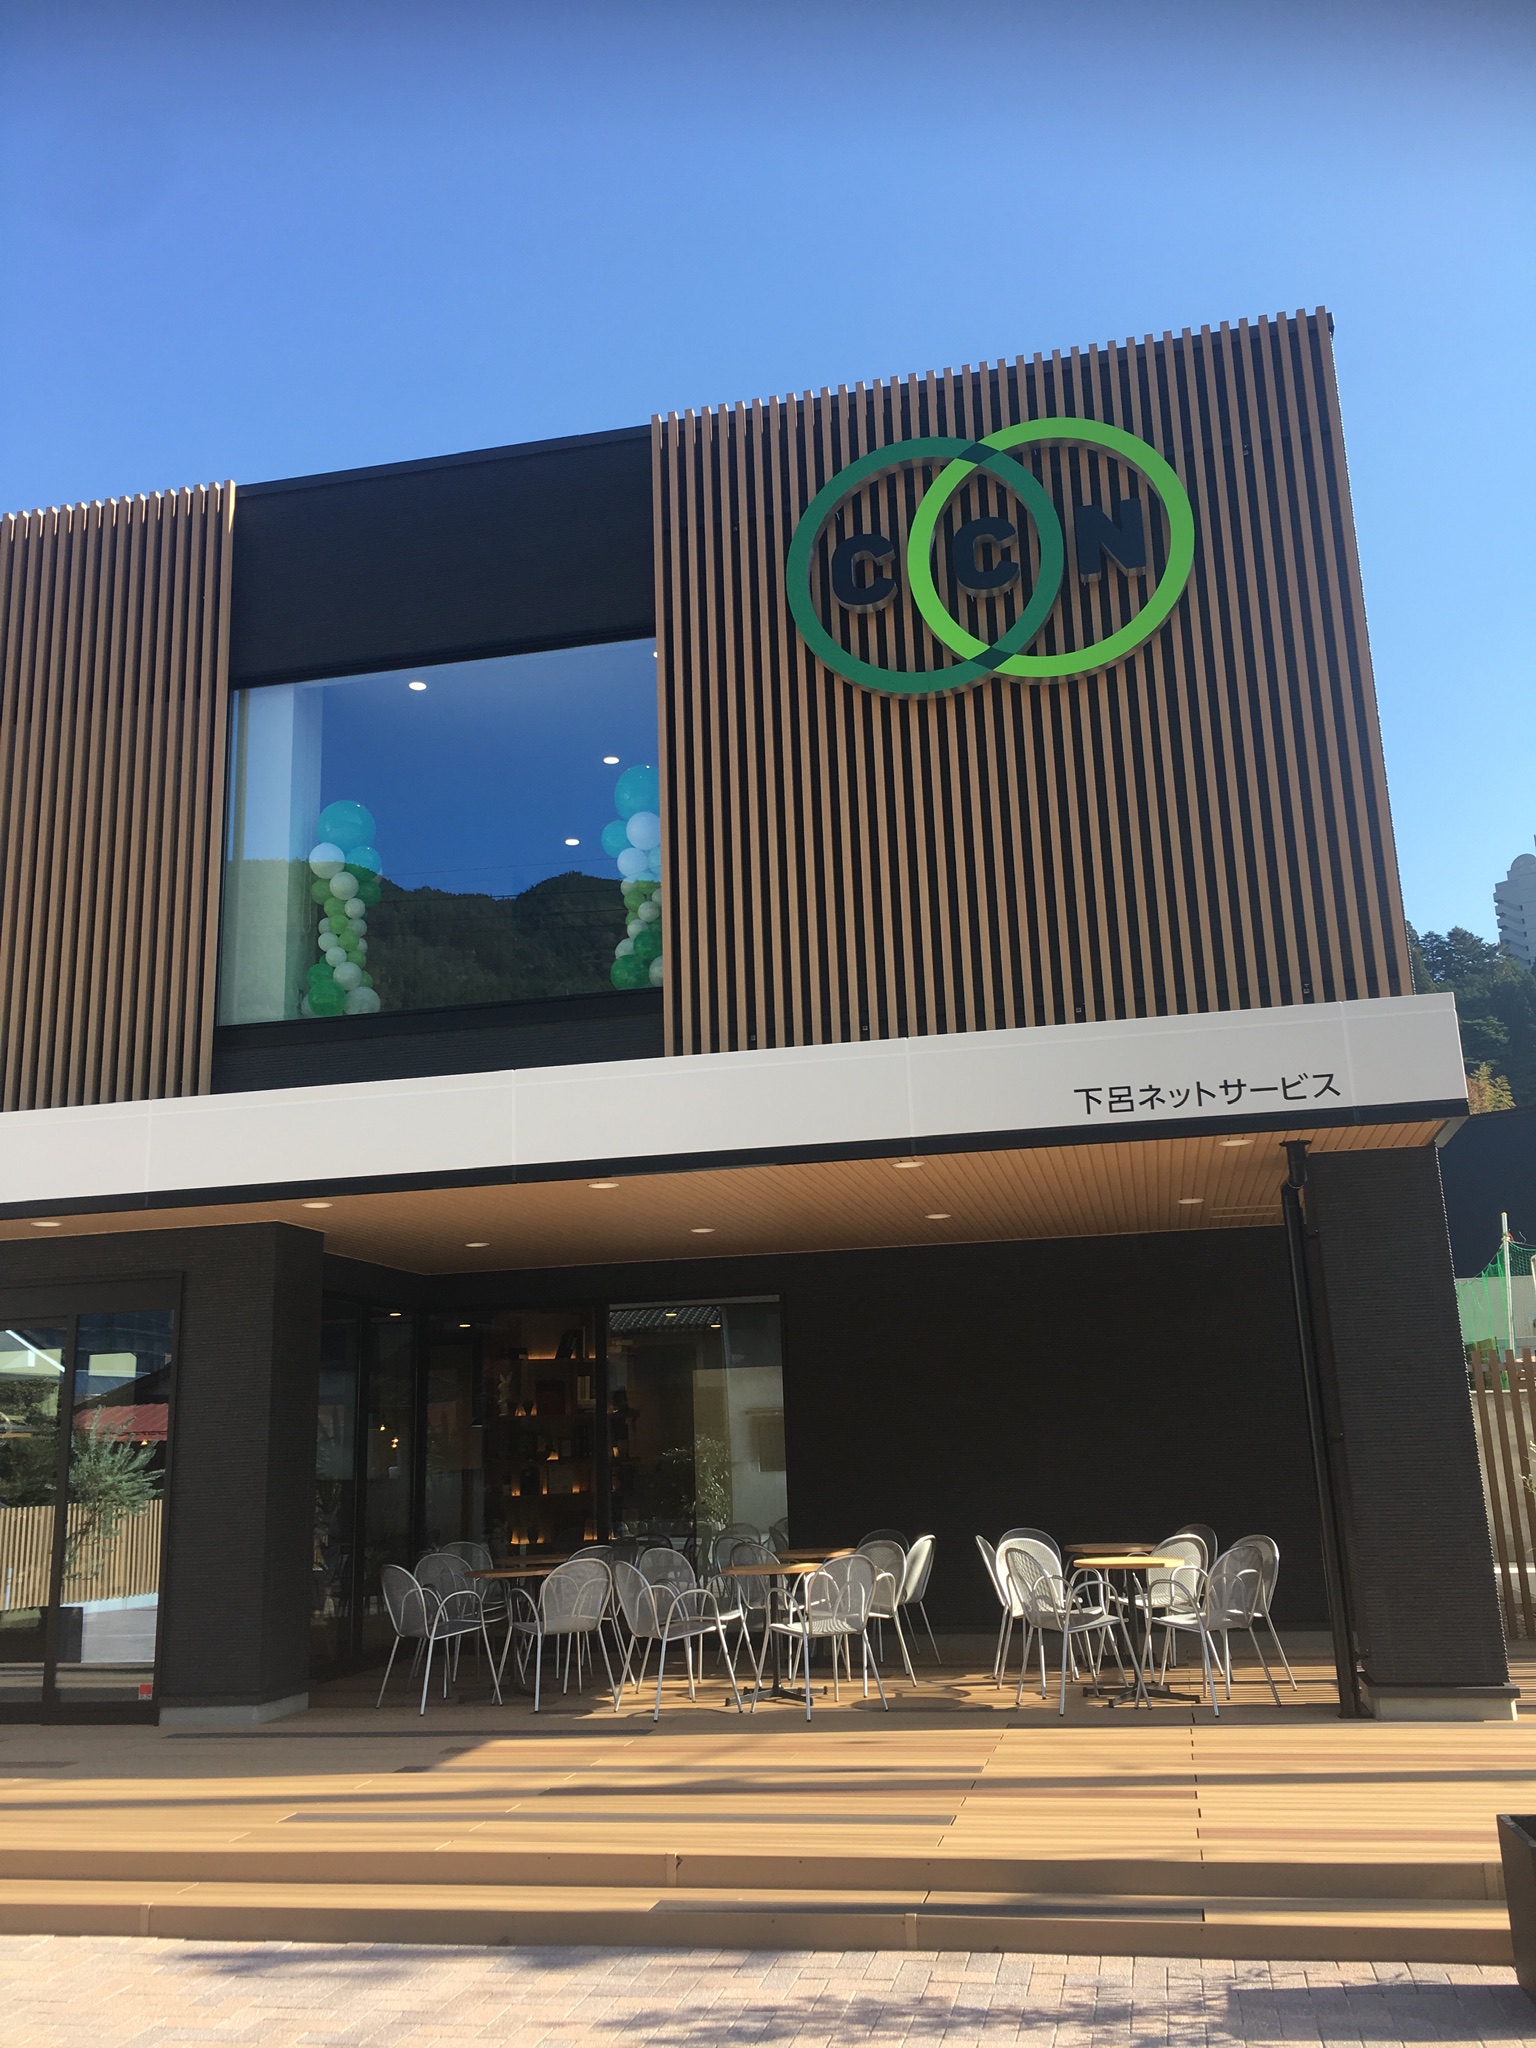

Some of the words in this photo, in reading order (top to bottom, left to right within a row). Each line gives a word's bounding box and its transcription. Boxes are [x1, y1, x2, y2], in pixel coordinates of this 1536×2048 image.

[831, 498, 1147, 613] CCN
[1073, 1072, 1342, 1115] 下呂ネットサービス
